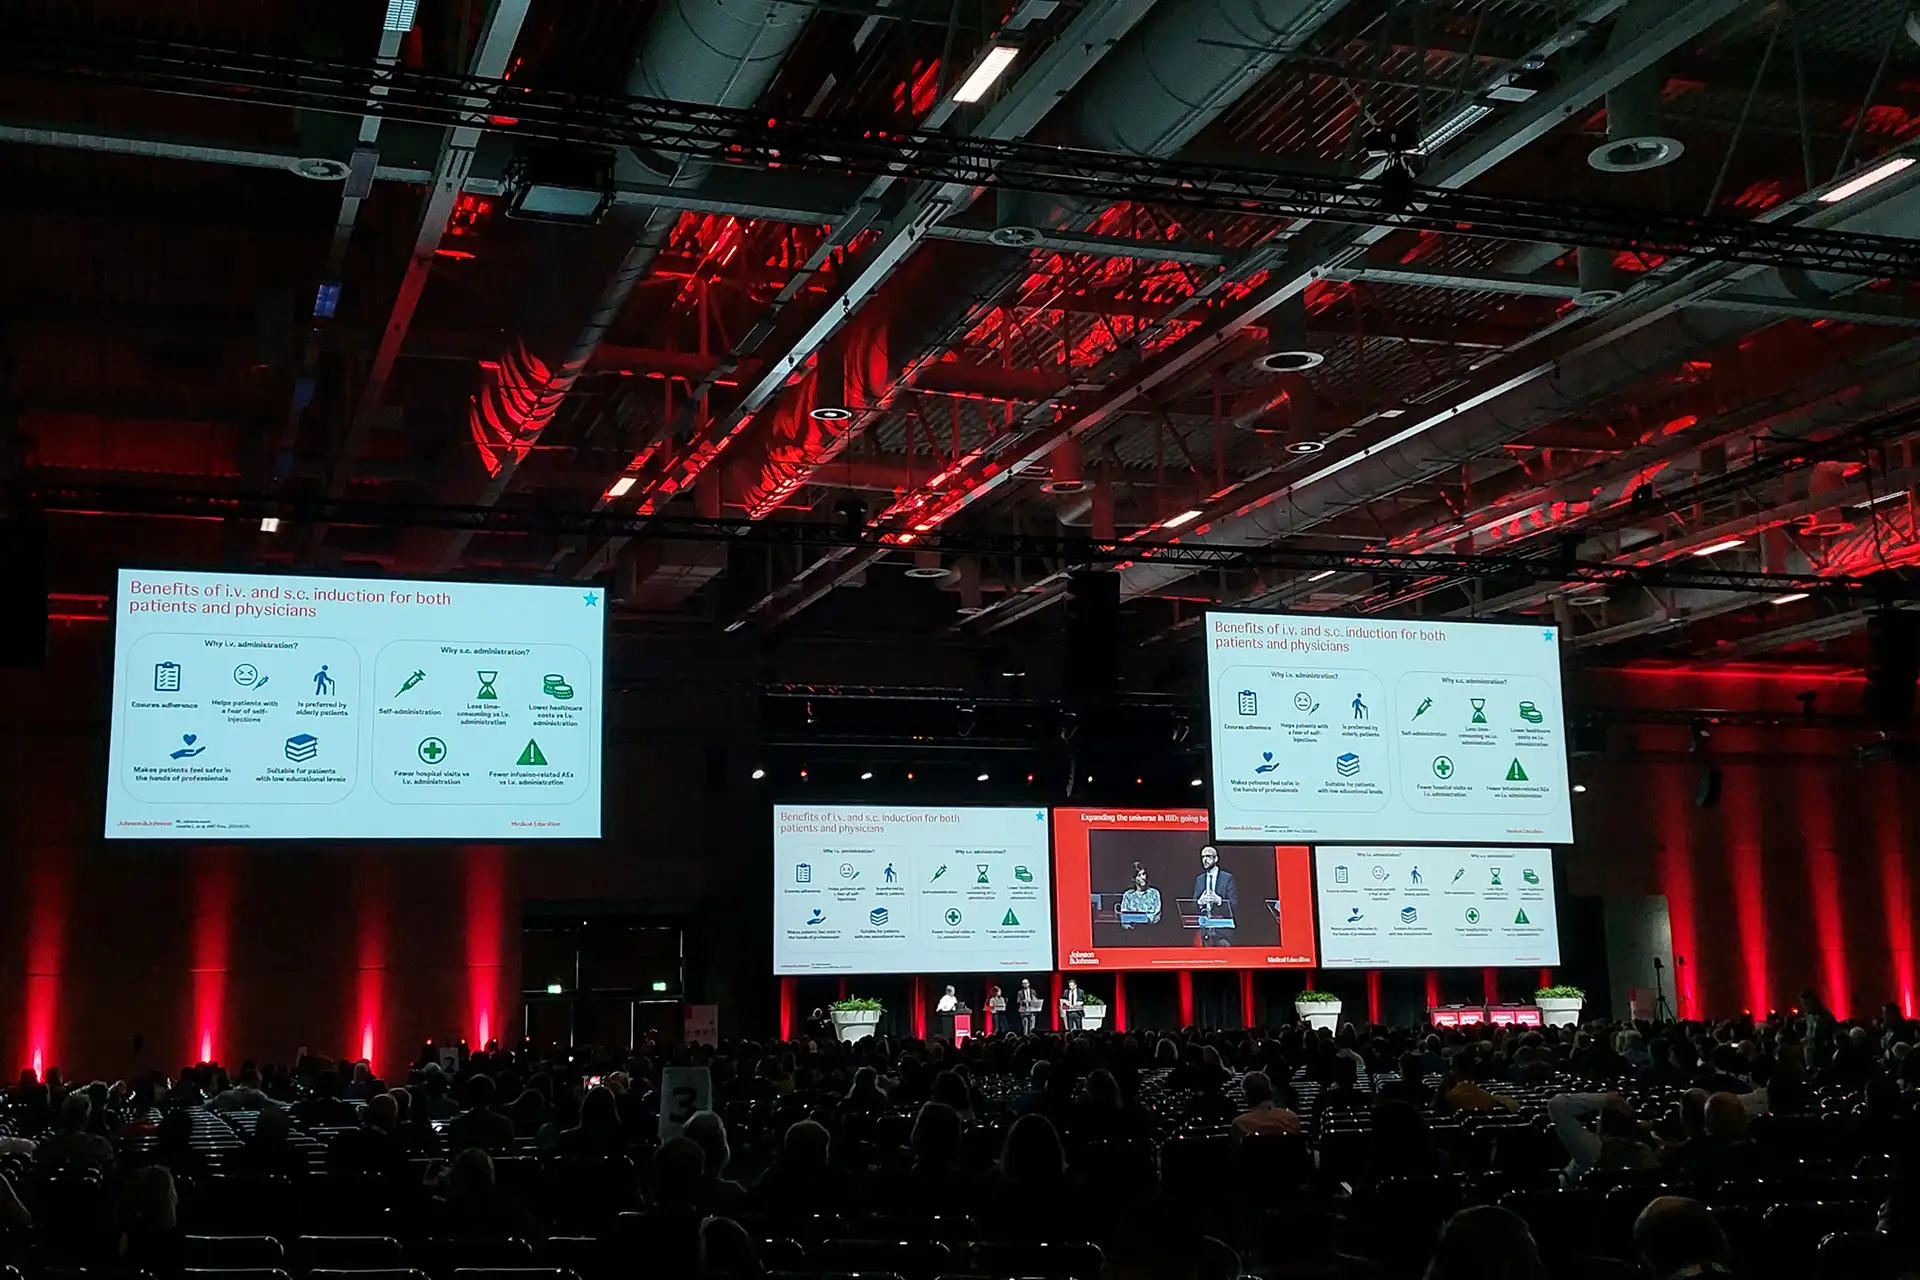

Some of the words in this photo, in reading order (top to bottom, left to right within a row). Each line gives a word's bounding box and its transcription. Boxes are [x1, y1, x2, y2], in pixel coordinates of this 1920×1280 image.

[130, 580, 199, 596] Benefits
[204, 584, 222, 597] of
[225, 584, 246, 598] i.v.
[251, 586, 279, 599] and
[284, 589, 309, 600] s.c.
[314, 587, 385, 603] induction
[390, 591, 412, 604] for
[416, 592, 451, 605] both
[129, 600, 197, 614] patients
[202, 602, 231, 615] and
[235, 602, 316, 618] physicians
[1215, 621, 1264, 634] Benefits
[1267, 624, 1280, 635] of
[1282, 625, 1297, 635] i.v.
[1301, 625, 1321, 636] and
[1324, 628, 1343, 637] s.c.
[1346, 626, 1398, 640] induction
[1401, 629, 1416, 640] for
[1420, 629, 1446, 641] both
[204, 640, 223, 649] Why
[238, 641, 298, 650] administration?
[1215, 637, 1263, 650] patients
[1267, 639, 1287, 650] and
[1290, 640, 1350, 653] physicians
[440, 647, 458, 655] Why
[474, 647, 530, 656] administration?
[1271, 671, 1284, 679] Why
[1441, 677, 1454, 685] Why
[296, 709, 319, 717] elderly
[378, 708, 441, 716] Self-administration
[416, 770, 442, 778] hospital
[181, 775, 228, 783] professionals
[780, 812, 819, 821] Benefits
[821, 813, 831, 821] of
[848, 814, 863, 822] and
[883, 814, 922, 823] induction
[925, 814, 937, 823] for
[1081, 814, 1116, 822] Expanding
[1129, 814, 1156, 822] universe
[1180, 815, 1199, 823] going
[780, 824, 818, 834] patients
[820, 824, 837, 832] and
[839, 825, 884, 834] physicians
[669, 1086, 698, 1122] 3
